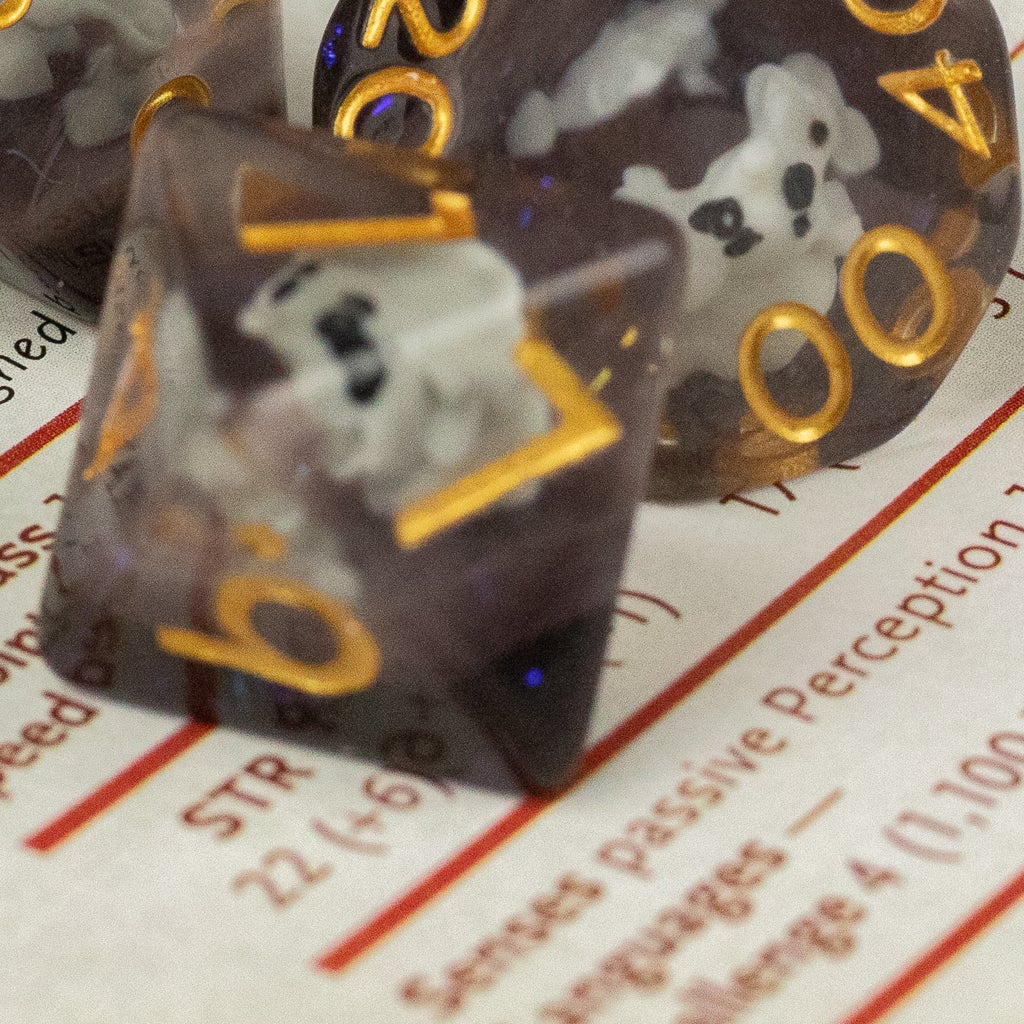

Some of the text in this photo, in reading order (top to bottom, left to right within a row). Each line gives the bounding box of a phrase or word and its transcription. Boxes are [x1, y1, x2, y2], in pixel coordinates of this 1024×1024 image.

[738, 224, 954, 444] 00
[180, 753, 314, 840] STR
[398, 516, 1024, 1020] Senses passive Perception
[229, 844, 334, 909] 22
[538, 838, 788, 1024] anguages
